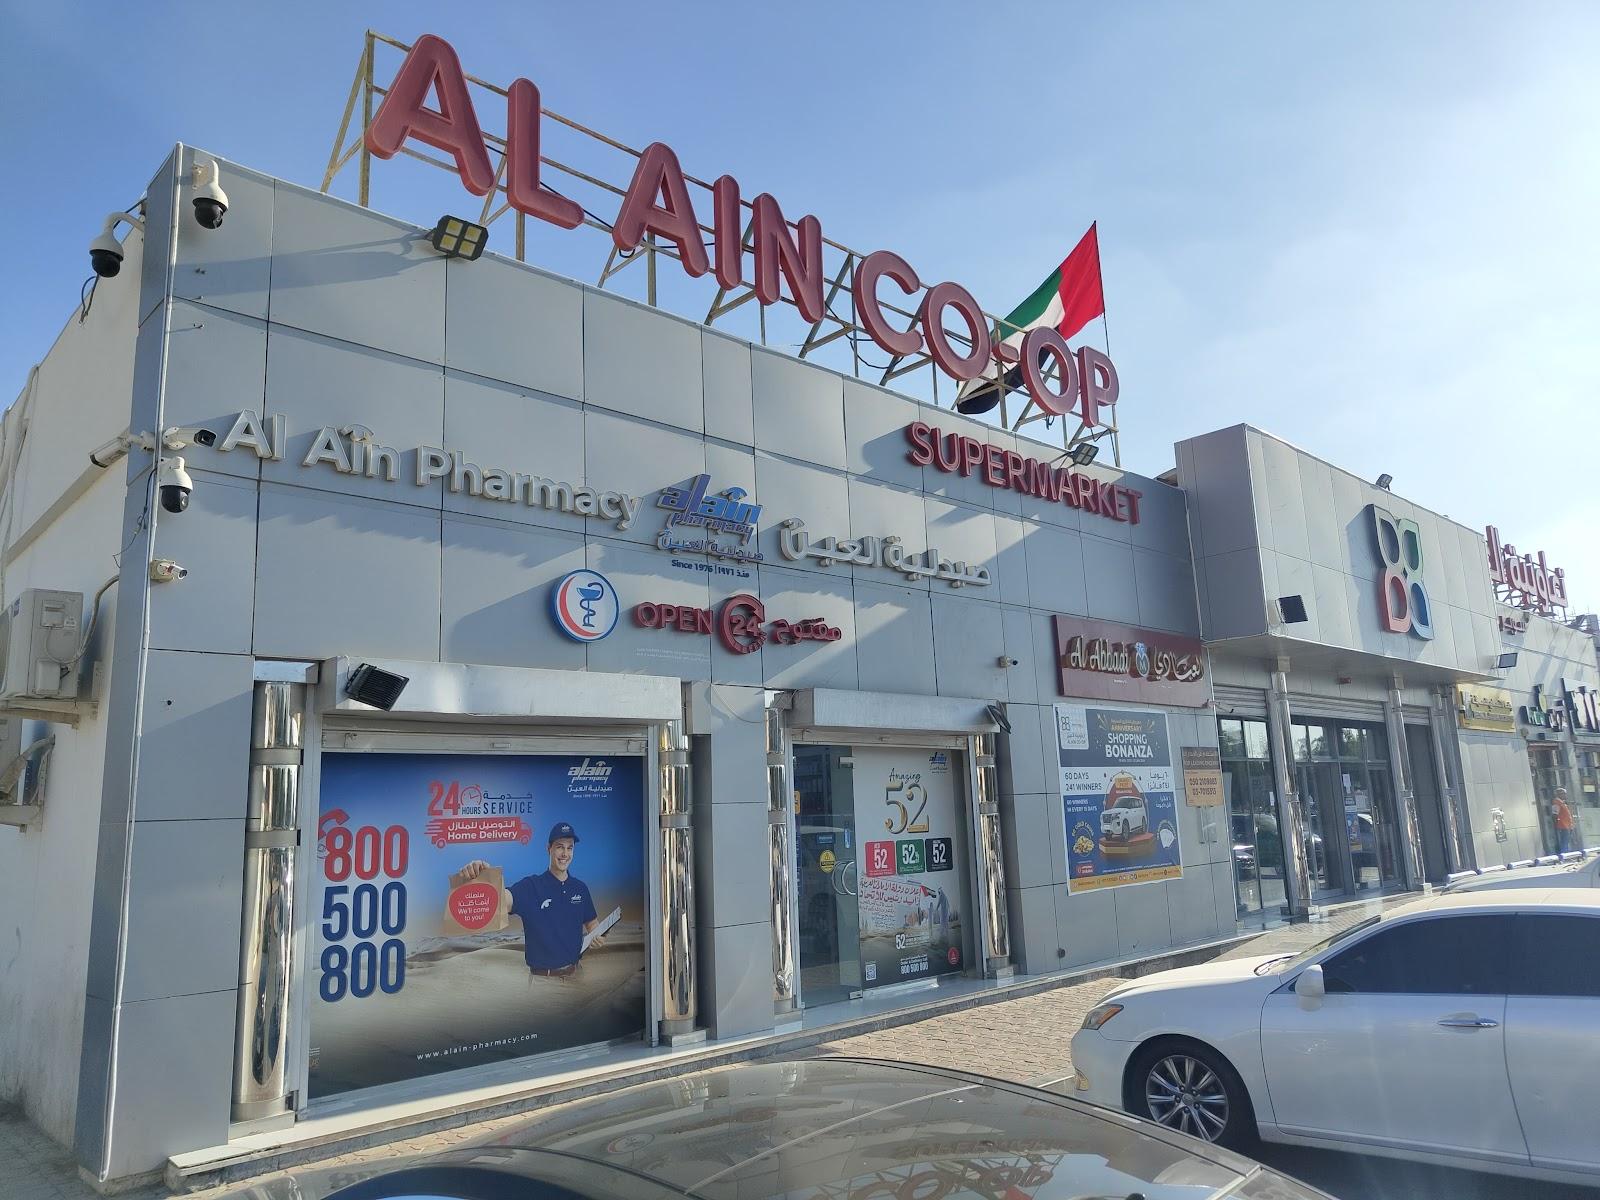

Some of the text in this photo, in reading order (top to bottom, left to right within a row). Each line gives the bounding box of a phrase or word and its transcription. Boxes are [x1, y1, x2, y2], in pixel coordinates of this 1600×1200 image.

[364, 34, 1120, 428] AL AIN CO-OP
[219, 408, 645, 531] Al Ain Pharmacy
[906, 421, 1143, 524] SUPERMARKET
[657, 474, 763, 525] alain
[667, 512, 754, 545] pharmacy
[671, 559, 693, 571] Since
[695, 562, 713, 573] 1976
[780, 517, 992, 588] صيدلية العين
[633, 601, 714, 634] OPEN
[730, 613, 761, 637] 24
[771, 617, 842, 645] مفتوح
[1071, 635, 1132, 674] Al Abbadi
[1105, 744, 1154, 758] BONANZA
[1107, 733, 1148, 745] SHOPPING
[1064, 772, 1090, 780] 60 DAYS
[1076, 783, 1102, 791] WINNERS
[427, 780, 460, 816] 24
[461, 801, 533, 815] HOURS SERVICE
[885, 781, 930, 835] 52
[447, 819, 516, 831] التوصيل للمنازل
[447, 830, 518, 840] Home Delivery
[324, 824, 410, 882] 800
[874, 848, 888, 869] 52
[932, 843, 947, 864] 52
[322, 881, 408, 942] 500
[896, 933, 906, 949] 52
[319, 938, 406, 1002] 800
[416, 1033, 538, 1061] www.alain-pharmacy.com
